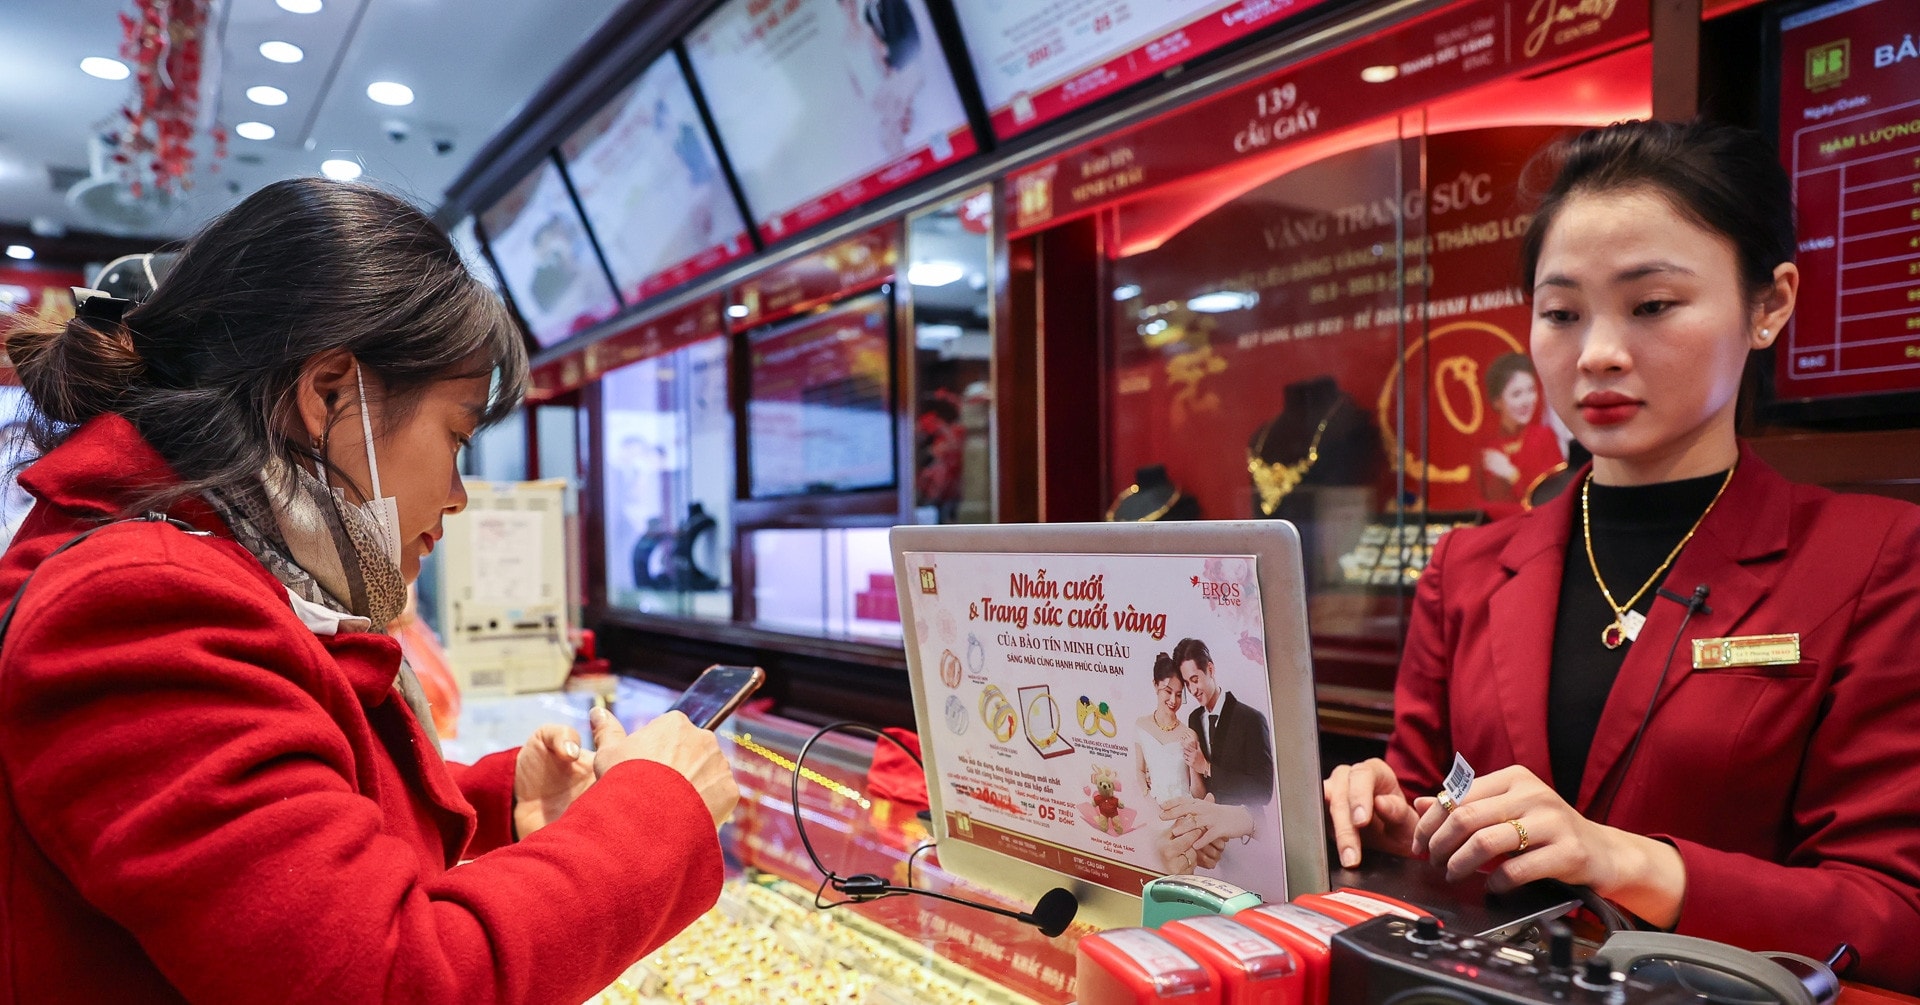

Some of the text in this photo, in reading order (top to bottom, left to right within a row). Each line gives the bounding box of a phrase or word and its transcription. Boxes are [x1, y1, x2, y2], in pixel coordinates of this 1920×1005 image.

[1874, 33, 1920, 69] BẢ
[1257, 82, 1297, 118] 139
[1233, 101, 1320, 153] CẦU GIẤY
[1263, 171, 1493, 251] VÀNG TRANG SỨC
[1010, 568, 1105, 602] Nhẫn cưới
[1202, 581, 1240, 598] EROS
[1218, 596, 1242, 607] Love
[969, 597, 1168, 641] & Trang sức cưới vàng
[997, 631, 1131, 659] CỦA BẢO TÍN MINH CHÂU
[1006, 653, 1124, 678] SÁNG MÃI CÙNG HẠNH PHÚC CỦA BẠN
[1038, 804, 1055, 820] 05
[1058, 808, 1074, 818] TRIỆU
[1051, 798, 1066, 808] TRANG
[1058, 816, 1075, 827] ĐỒNG
